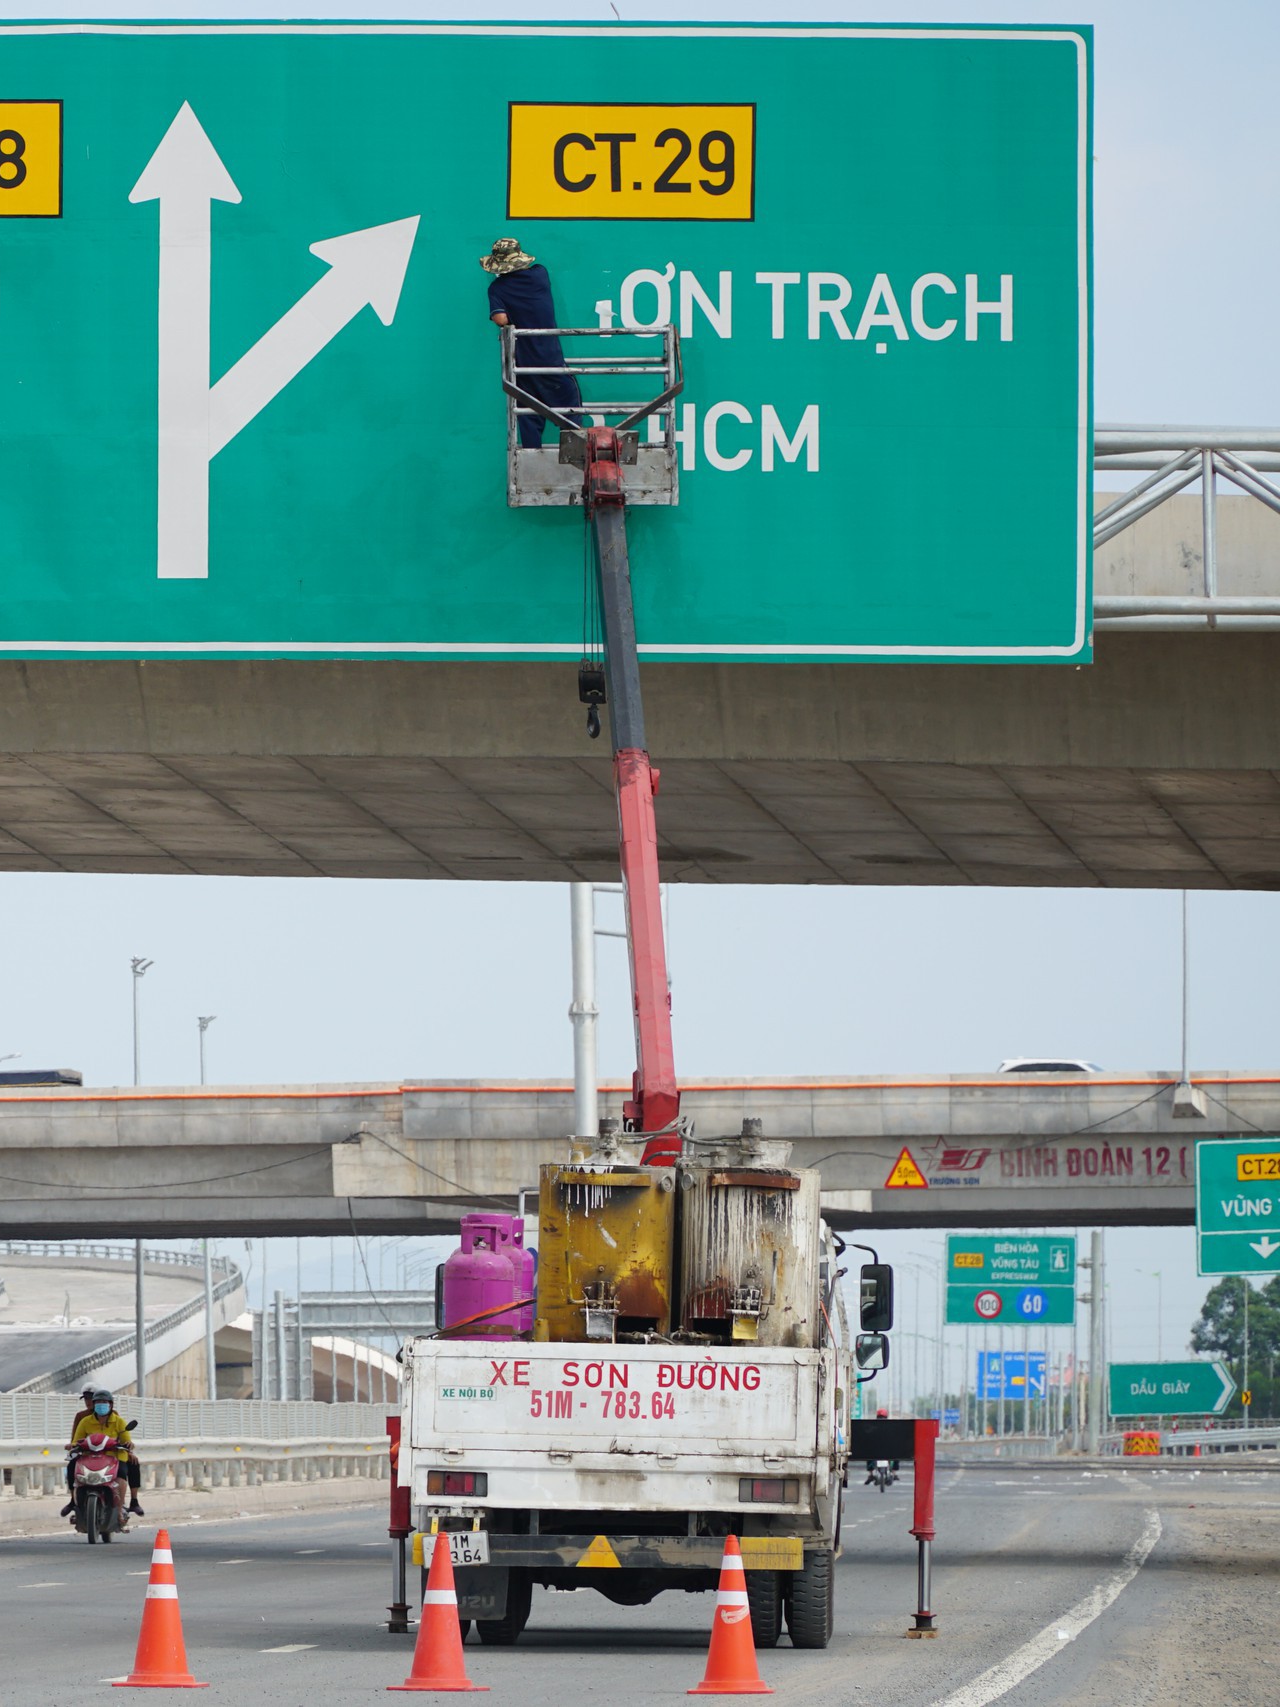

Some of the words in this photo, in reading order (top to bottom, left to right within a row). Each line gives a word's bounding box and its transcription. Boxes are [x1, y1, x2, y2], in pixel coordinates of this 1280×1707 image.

[553, 128, 736, 195] CT.29
[755, 272, 1014, 354] TRẠCH
[1067, 1140, 1133, 1177] ĐOÀN
[1142, 1147, 1170, 1175] 12
[1221, 1194, 1273, 1217] VŨNG
[991, 1256, 1018, 1269] VŨNG
[1020, 1257, 1040, 1269] TÀU
[980, 1299, 999, 1312] 100
[1022, 1294, 1043, 1314] 60
[489, 1361, 531, 1386] XE
[562, 1359, 629, 1388] SƠN
[656, 1355, 761, 1391] ĐƯỜNG
[442, 1388, 457, 1398] XE
[458, 1386, 477, 1400] NỘI
[478, 1387, 494, 1401] BỘ
[1130, 1378, 1157, 1395] DẦU
[1162, 1379, 1191, 1395] GIÂY
[530, 1390, 573, 1419] 51M
[601, 1391, 675, 1419] 783.64
[452, 1535, 470, 1549] 1M
[450, 1549, 482, 1564] 3.64
